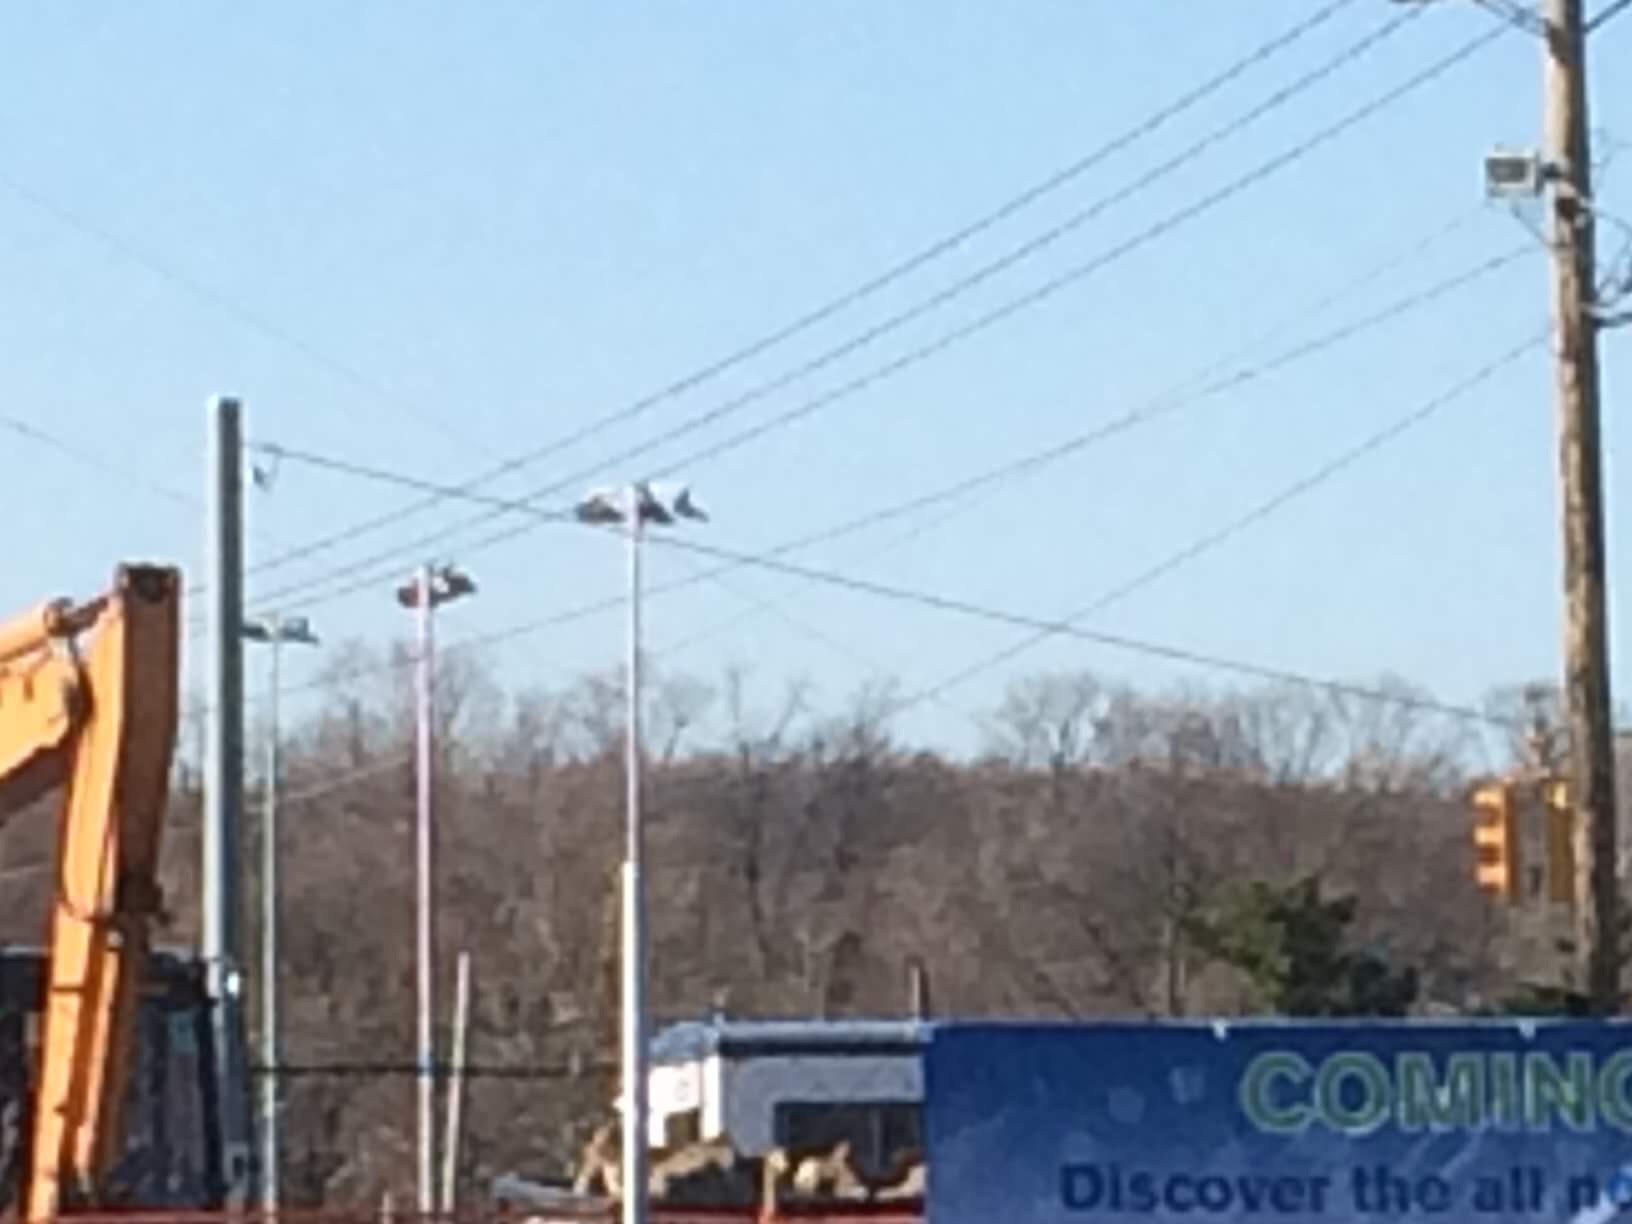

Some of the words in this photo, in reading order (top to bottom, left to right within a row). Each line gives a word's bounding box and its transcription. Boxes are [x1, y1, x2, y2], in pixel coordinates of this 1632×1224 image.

[1060, 1162, 1332, 1215] Discover
[1349, 1164, 1452, 1213] the
[1474, 1163, 1544, 1213] all
